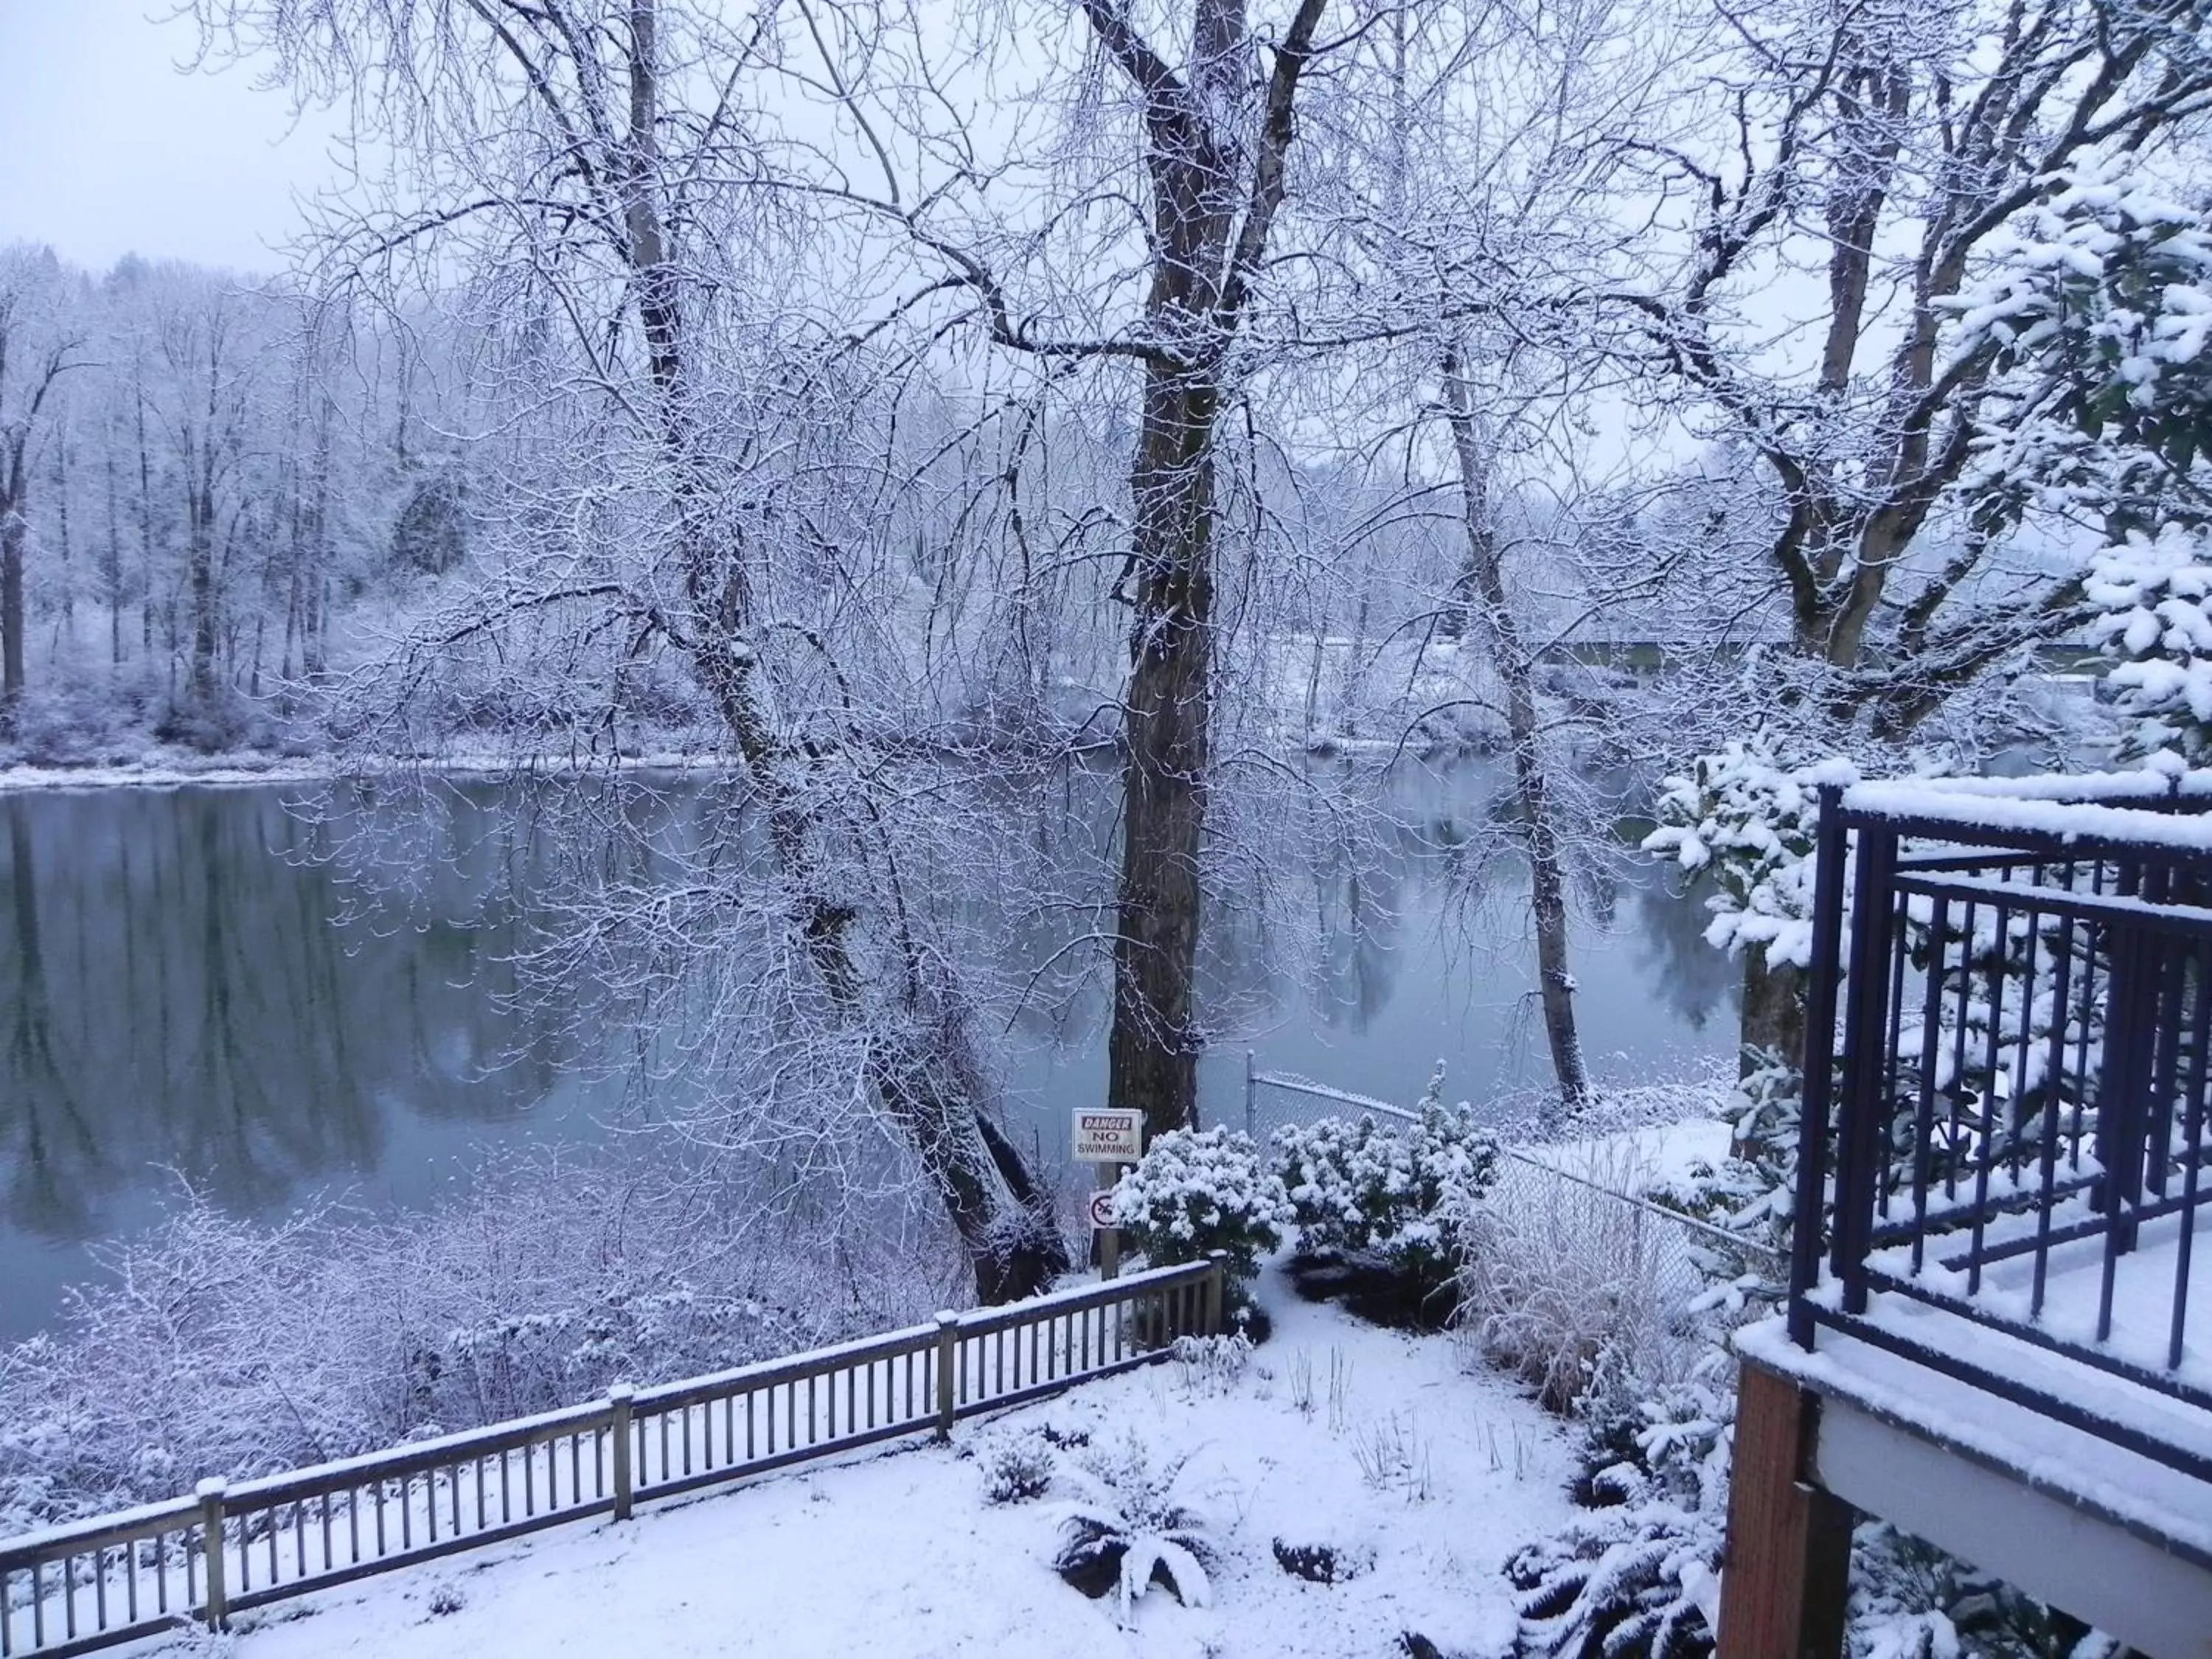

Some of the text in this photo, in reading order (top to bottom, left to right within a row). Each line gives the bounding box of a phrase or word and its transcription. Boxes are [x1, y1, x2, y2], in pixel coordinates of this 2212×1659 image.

[1085, 1118, 1130, 1129] DANGER
[1092, 1132, 1119, 1141] NO
[1077, 1144, 1135, 1154] SWIMMING
